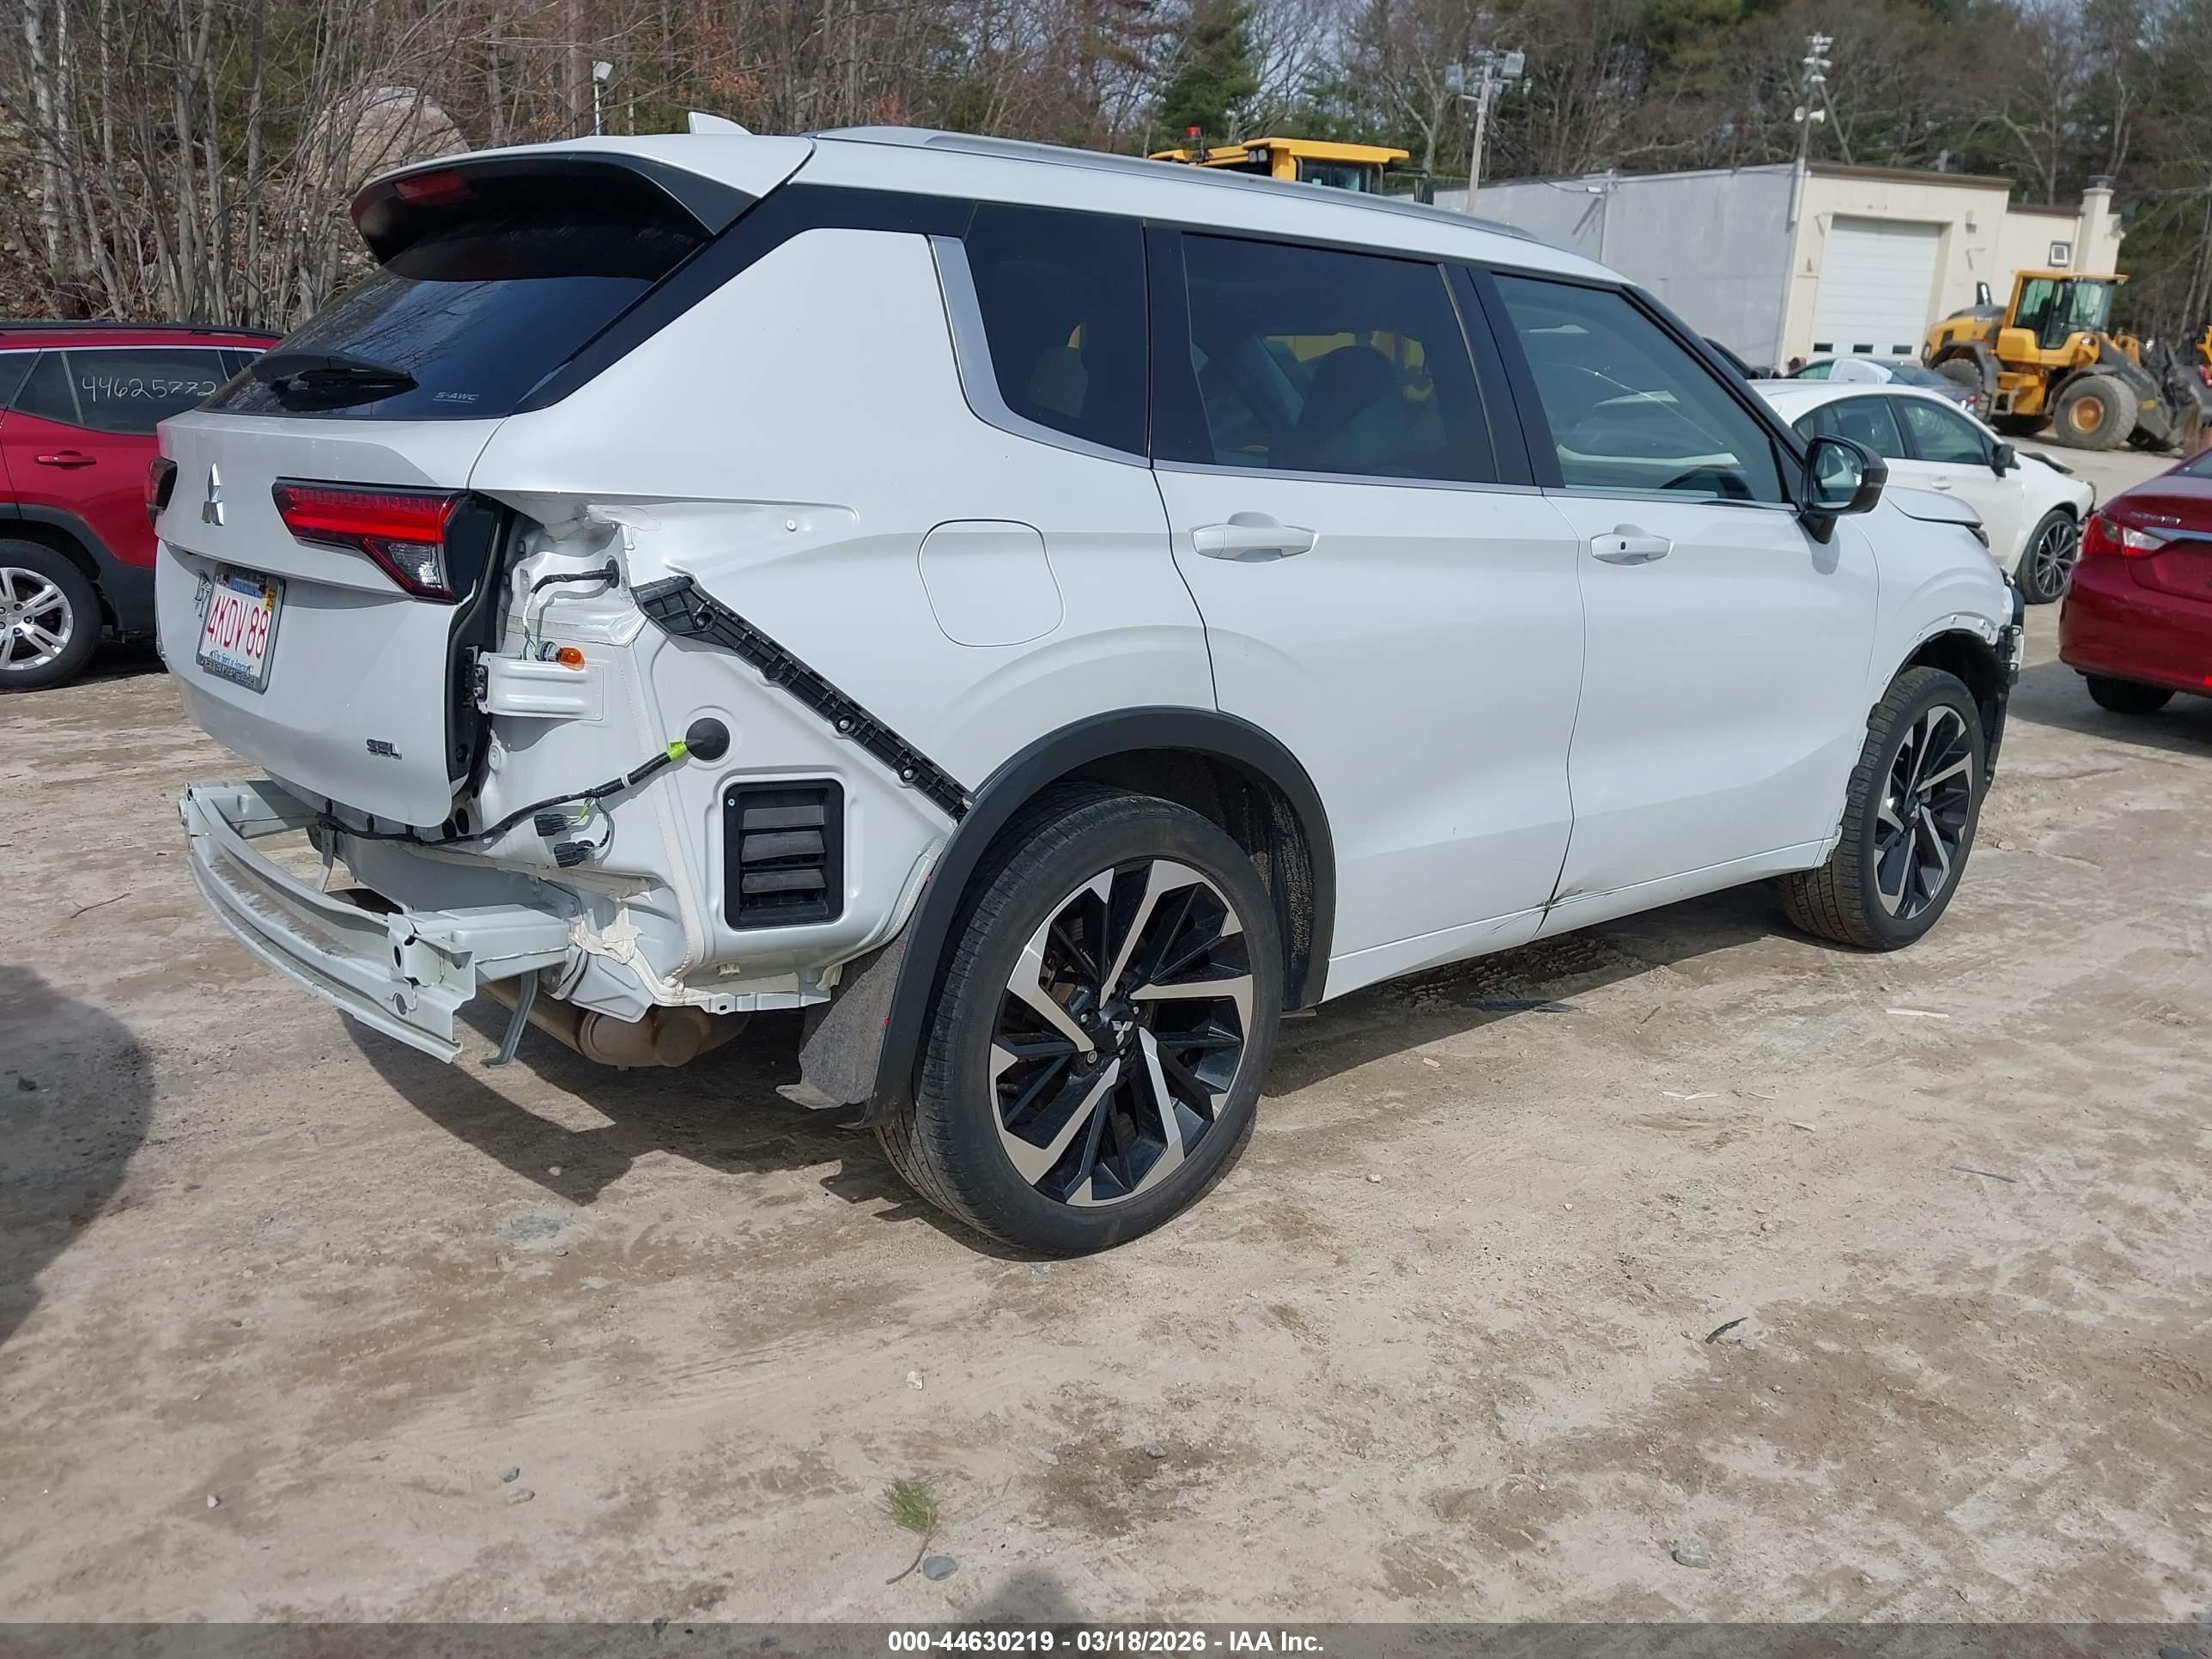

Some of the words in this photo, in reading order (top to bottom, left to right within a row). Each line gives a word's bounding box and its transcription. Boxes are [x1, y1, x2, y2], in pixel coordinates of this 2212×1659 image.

[82, 375, 217, 403] 44625772
[207, 594, 250, 653] 4KDV
[246, 605, 270, 660] 88
[366, 738, 401, 759] SEL
